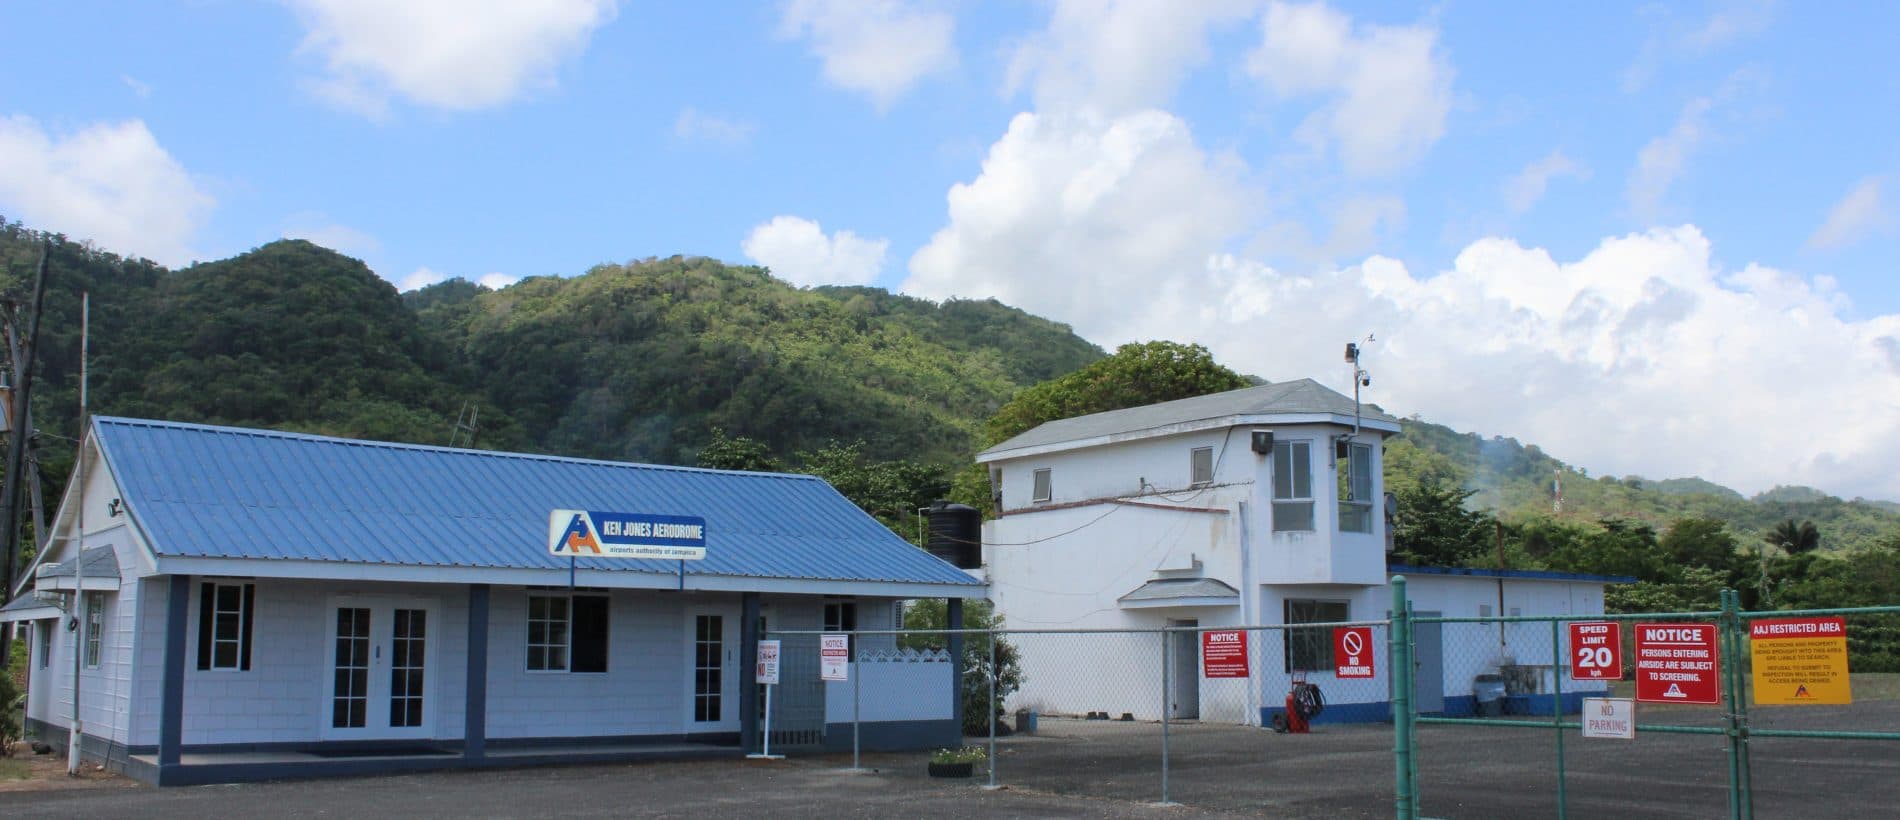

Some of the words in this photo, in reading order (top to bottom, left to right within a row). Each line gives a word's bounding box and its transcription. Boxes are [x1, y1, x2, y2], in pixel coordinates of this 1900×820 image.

[603, 521, 622, 536] KEN
[623, 521, 651, 537] JONES
[652, 524, 703, 539] AERODROME
[609, 546, 635, 554] airports
[635, 546, 663, 555] authority
[1579, 626, 1608, 634] SPEED
[1753, 625, 1769, 635] AAJ
[1769, 623, 1817, 634] RESTRICTED
[1818, 622, 1841, 633] AREA
[1210, 632, 1239, 642] NOTICE
[1582, 636, 1607, 644] LIMIT
[1645, 628, 1702, 642] NOTICE
[824, 639, 844, 648] NOTICE
[1578, 647, 1613, 668] 20
[1641, 648, 1672, 658] PERSONS
[1673, 649, 1709, 658] ENTERING
[1349, 656, 1360, 666] NO
[1638, 661, 1664, 669] AIRSIDE
[1665, 661, 1679, 670] ARE
[1680, 661, 1713, 670] SUBJECT
[1338, 666, 1371, 676] SMOKING
[1649, 672, 1659, 681] TO
[1659, 673, 1701, 682] SCREENING.
[1600, 705, 1614, 717] NO
[1588, 719, 1628, 732] PARKING
